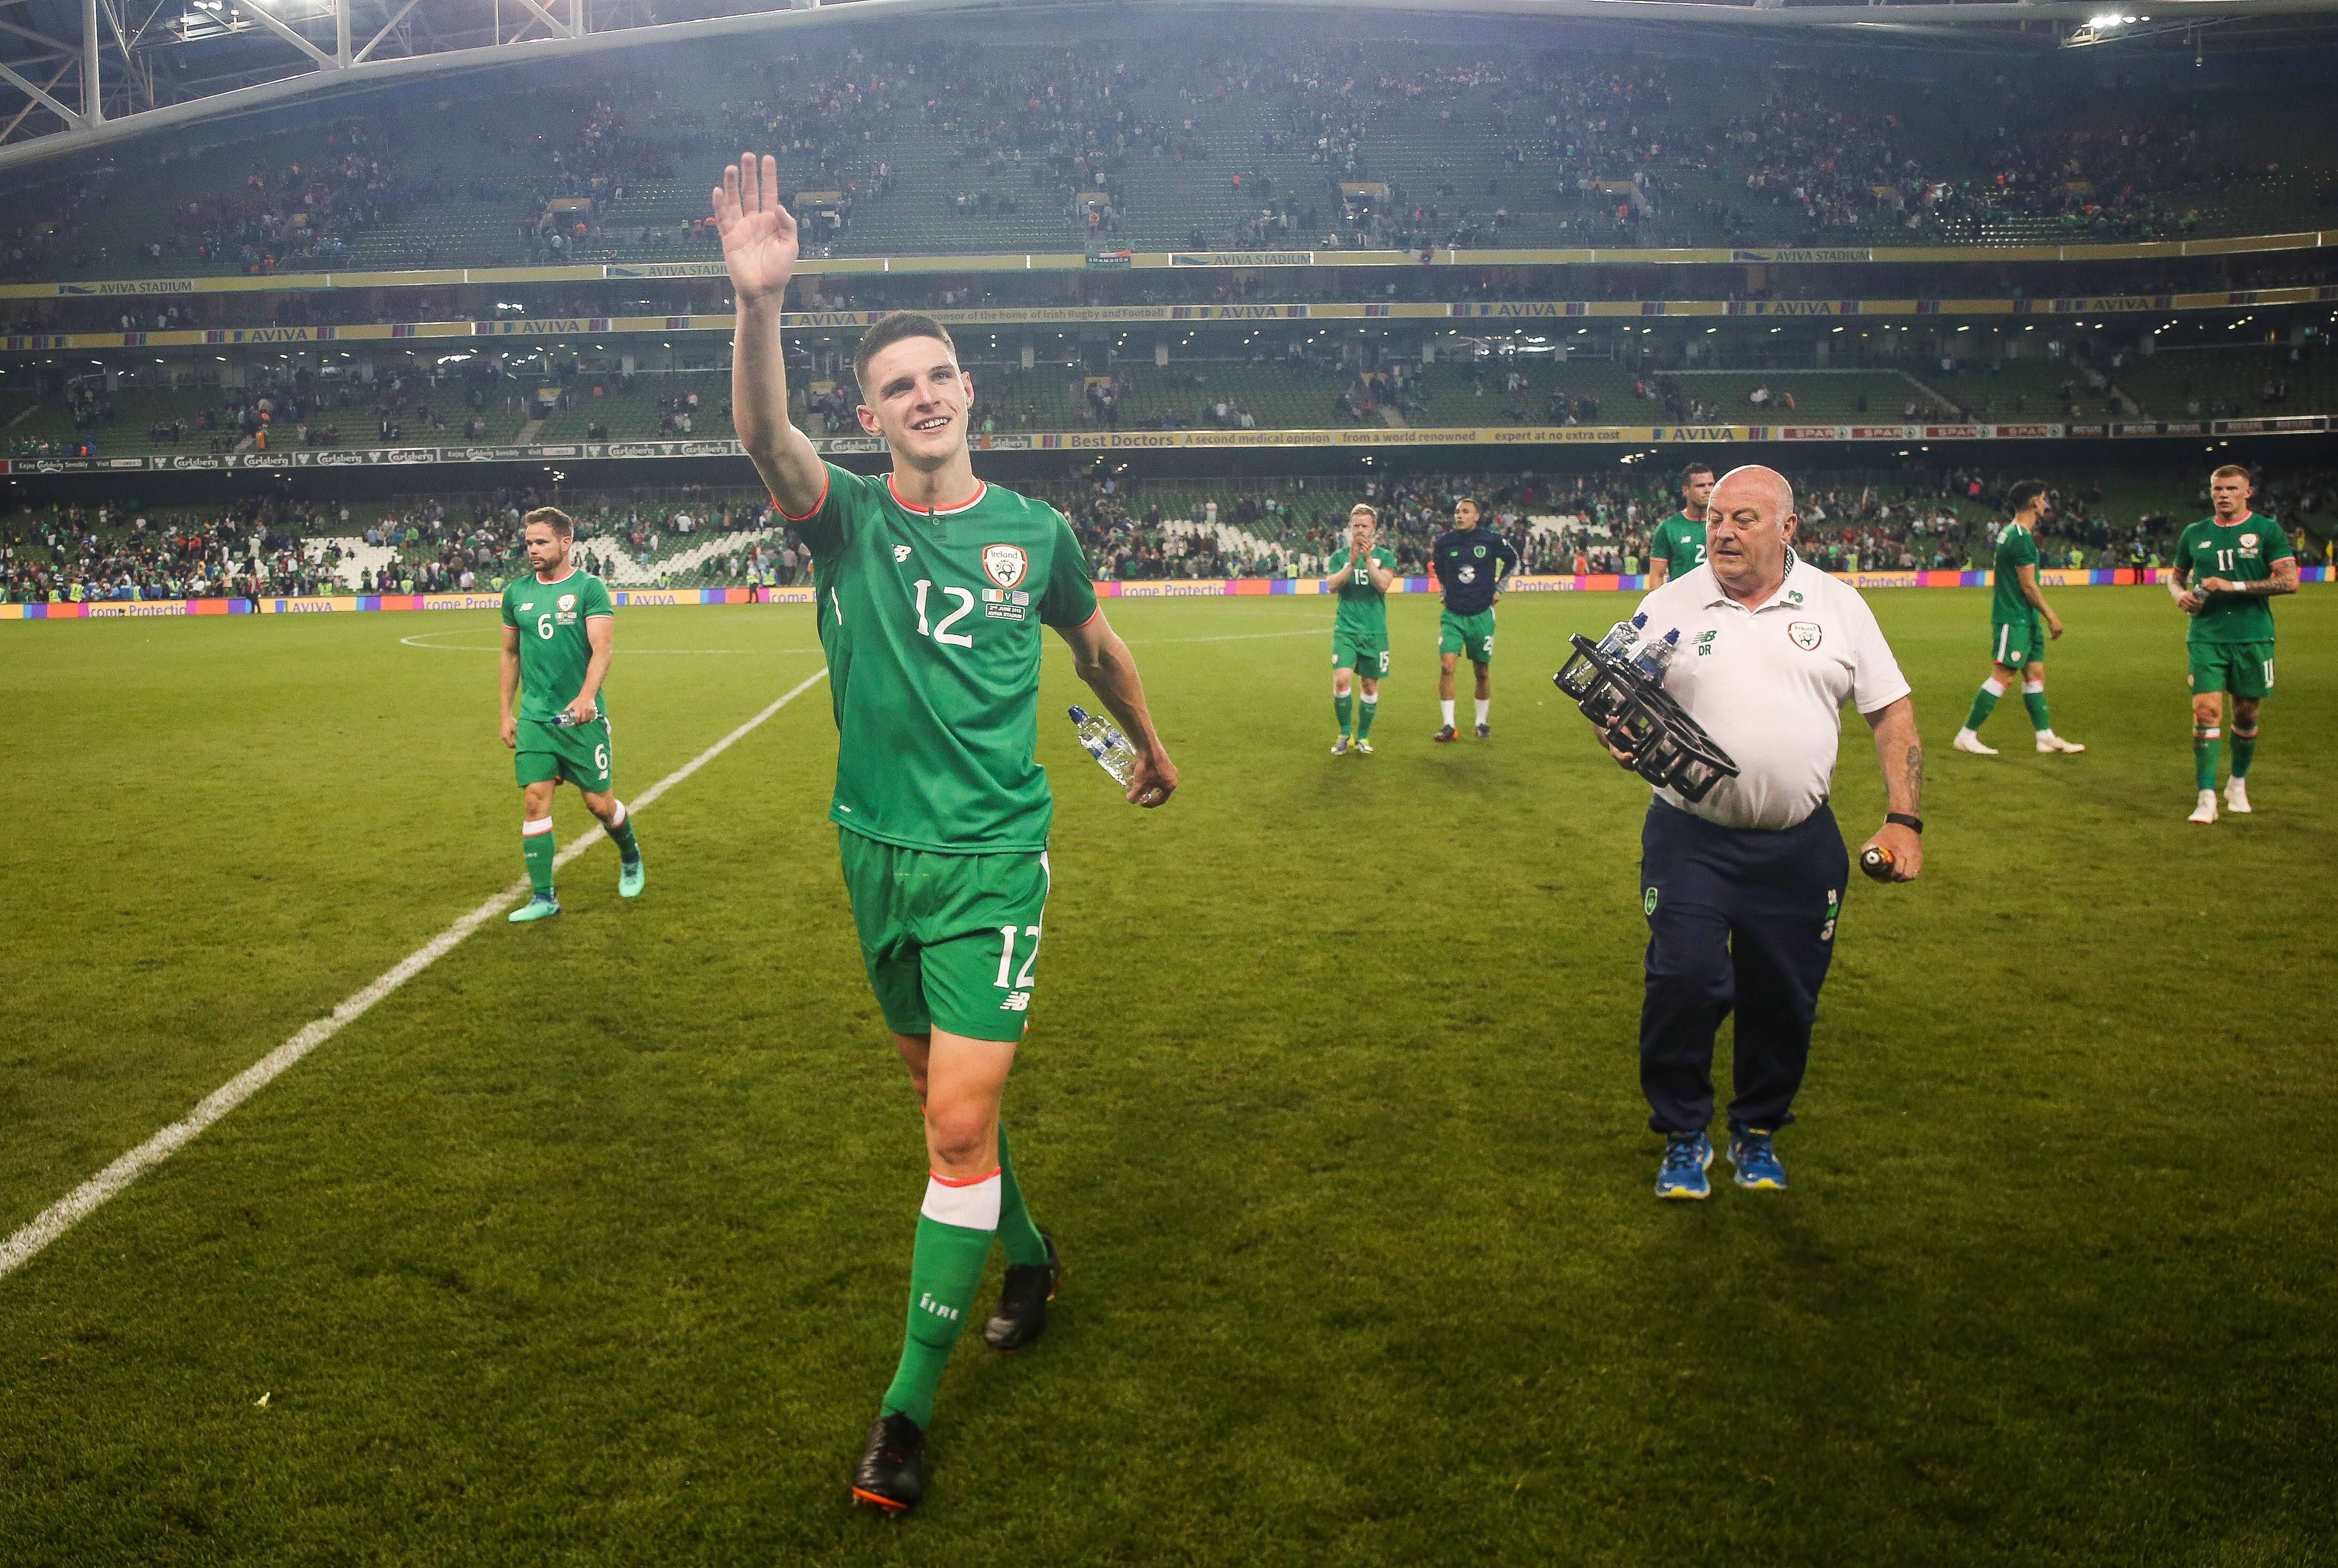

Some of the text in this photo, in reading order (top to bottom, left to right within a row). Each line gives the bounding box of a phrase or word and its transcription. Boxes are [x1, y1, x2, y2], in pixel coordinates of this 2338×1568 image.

[1215, 254, 1309, 265] AVIVA STADIUM
[1776, 251, 1868, 261] AVIVA STADIUM
[648, 266, 685, 276] AVIVA
[101, 282, 192, 294] AVIVA STADIUM
[1500, 304, 1556, 316] AVIVA
[1775, 302, 1831, 315] AVIVA
[2094, 298, 2149, 310] AVIVA
[1123, 309, 1164, 318] Football
[1221, 306, 1277, 318] AVIVA
[524, 320, 580, 333] AVIVA
[800, 314, 857, 326] AVIVA
[252, 328, 308, 342] AVIVA
[1071, 435, 1174, 447] Best Doctors
[1186, 435, 1192, 443] A
[1196, 434, 1235, 443] second
[1239, 434, 1283, 443] medical
[1287, 433, 1329, 444] opinion
[1343, 433, 1370, 442] from
[1383, 432, 1415, 441] world
[1420, 432, 1476, 441] renowned
[1496, 432, 1531, 441] expert
[1673, 428, 1734, 441] AVIVA
[608, 444, 655, 457] Carlsberg
[681, 442, 728, 455] Carlsberg
[830, 439, 878, 452] Carlsberg
[173, 456, 219, 469] Carlsberg
[243, 453, 289, 468] Carlsberg
[317, 452, 362, 465] Carlsberg
[387, 450, 434, 464] Carlsberg
[991, 550, 1018, 559] Ireland
[1695, 543, 1706, 564] 2
[2217, 548, 2234, 571] 11
[1353, 568, 1369, 585] 15
[634, 596, 675, 606] AVIVA
[293, 603, 333, 613] AVIVA
[913, 579, 975, 649] 12
[537, 613, 555, 640] 6
[1698, 644, 1711, 656] DR
[594, 743, 609, 770] 6
[993, 925, 1039, 988] 12
